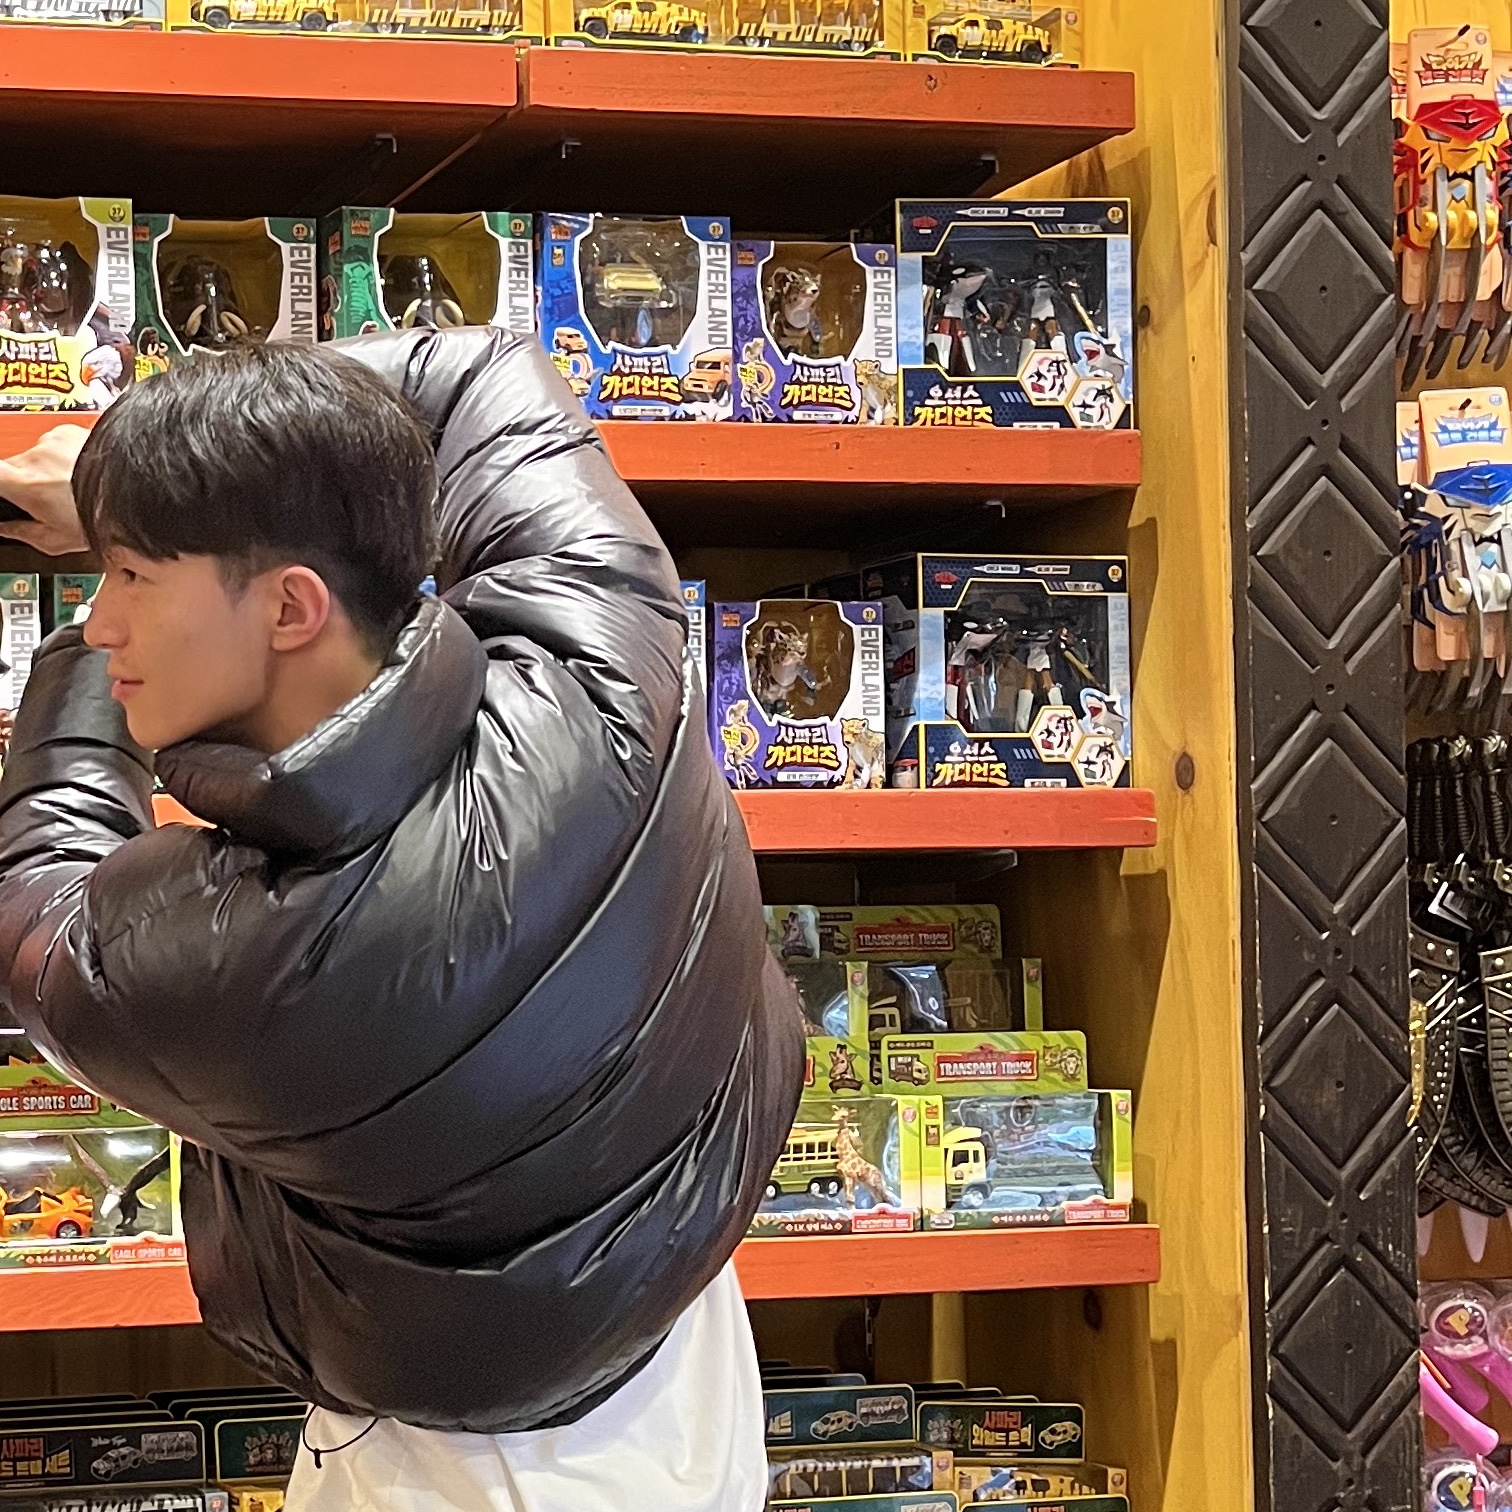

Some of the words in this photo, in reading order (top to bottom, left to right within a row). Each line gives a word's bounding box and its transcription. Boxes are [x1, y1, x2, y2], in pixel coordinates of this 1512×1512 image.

[289, 246, 313, 339] EVERLAN
[507, 241, 530, 331] EVERLAN
[706, 244, 728, 346] EVERLAND
[873, 268, 892, 359] EVERLAND
[612, 353, 668, 375] 사파리
[793, 363, 843, 384] 사파리
[600, 374, 682, 402] 가디언즈
[782, 384, 854, 406] 가디언즈
[924, 384, 983, 406] 오션스
[913, 405, 995, 428] 가디언즈
[860, 627, 881, 717] EVERLAND
[776, 726, 828, 745] 사파리
[766, 744, 840, 767] 가디언즈
[947, 742, 998, 762] 오션스
[933, 761, 1011, 787] 가디언즈
[858, 932, 913, 947] TRANSPORT
[918, 932, 949, 946] TRUCK
[939, 1061, 997, 1076] TRANSPORT
[1001, 1060, 1032, 1075] TRUCK
[22, 1095, 65, 1110] SPORTS
[69, 1094, 92, 1109] CAR
[984, 1411, 1021, 1428] 사파리
[0, 1437, 43, 1459] 사파리
[45, 1449, 71, 1474] 세트
